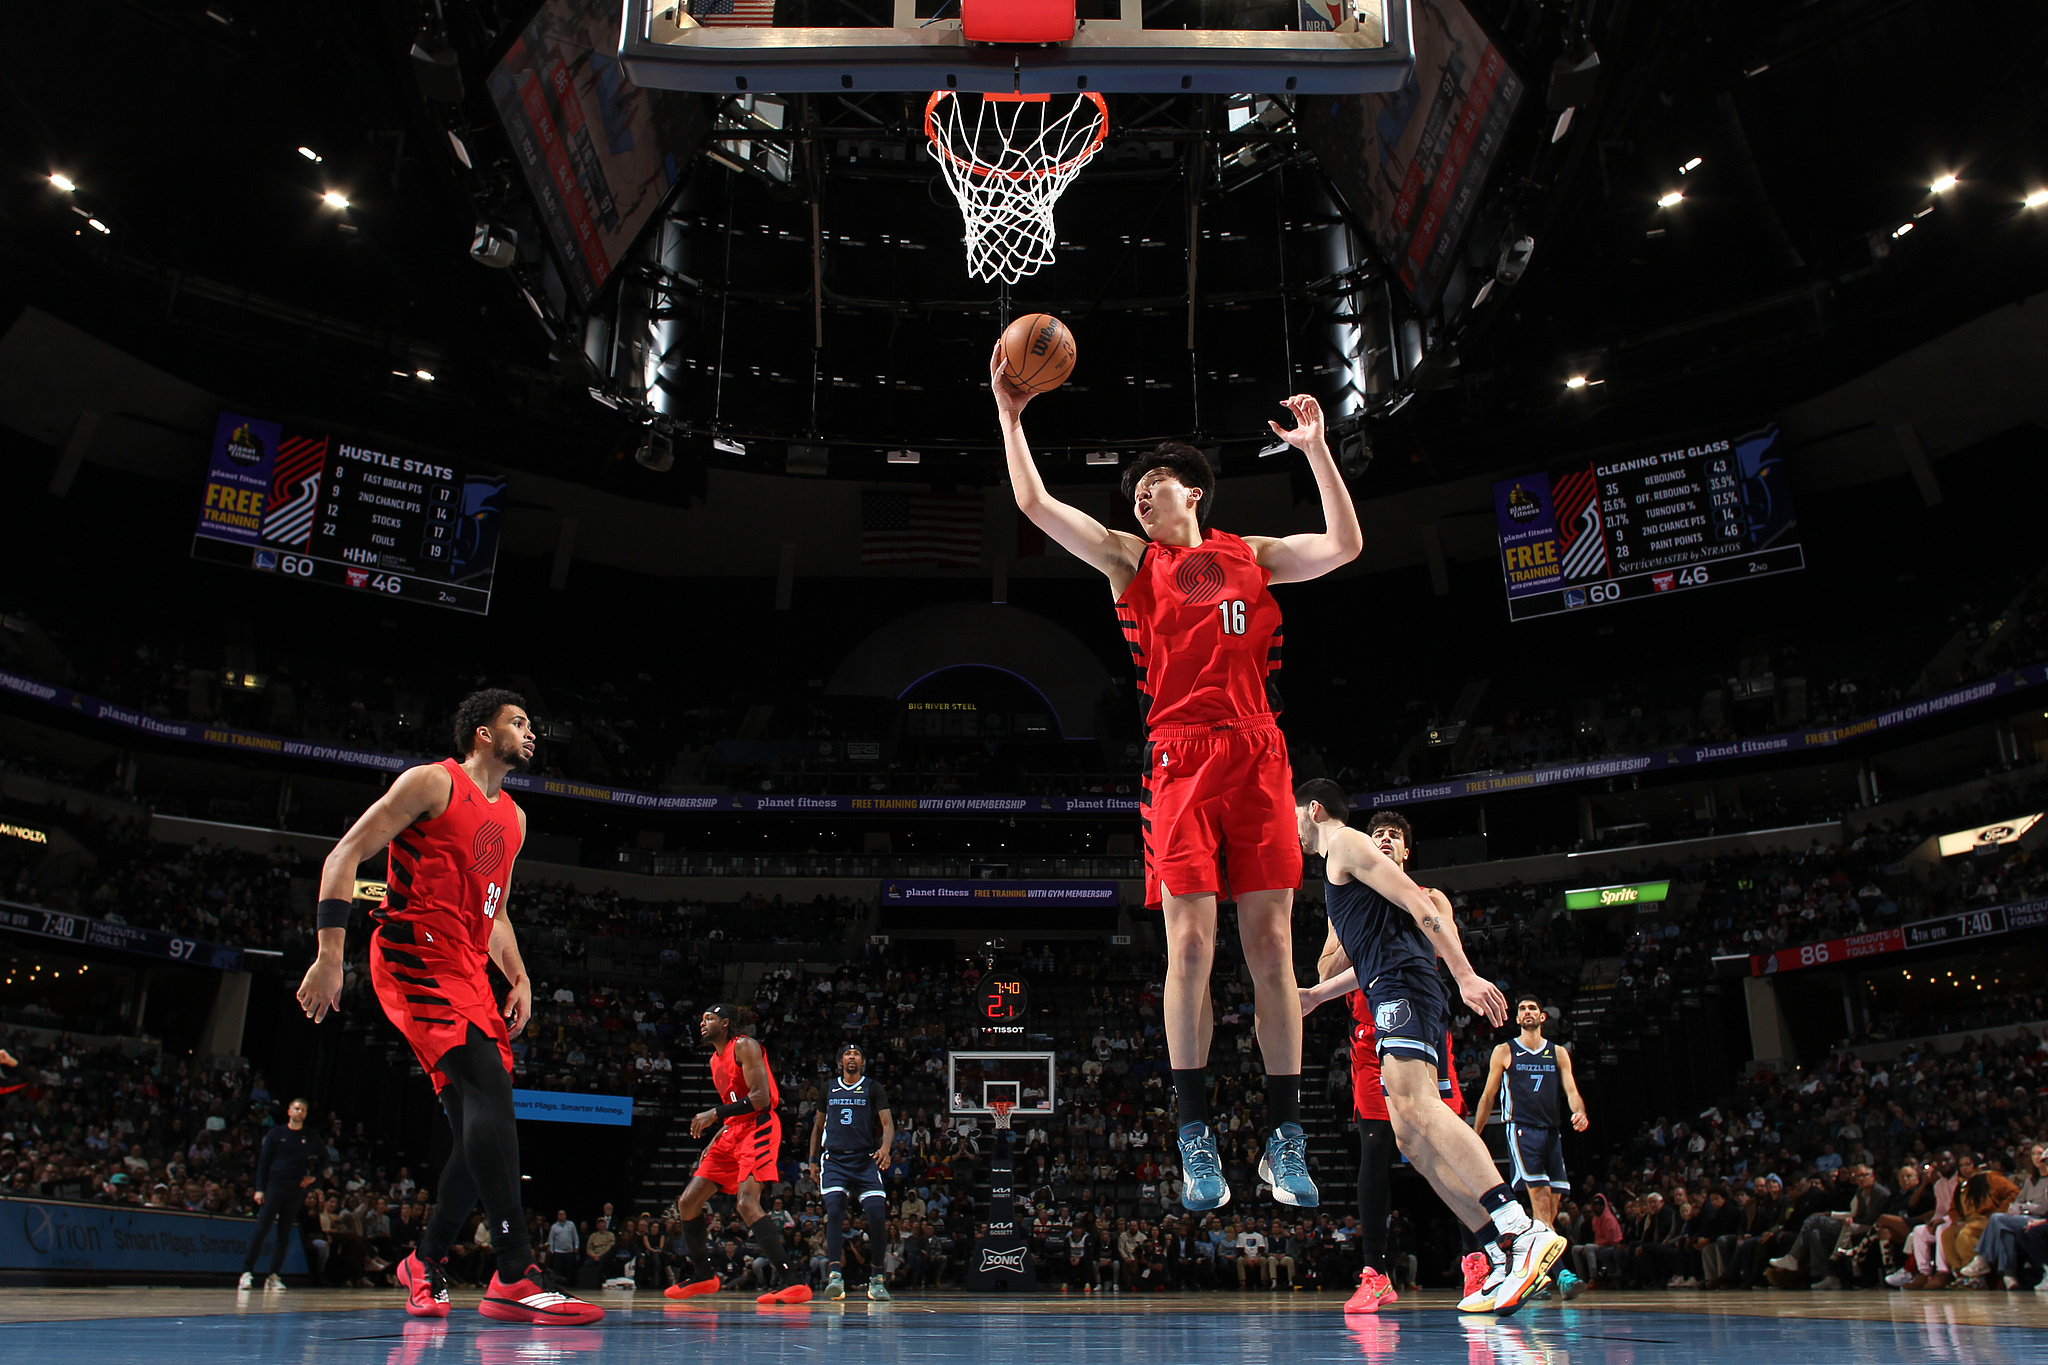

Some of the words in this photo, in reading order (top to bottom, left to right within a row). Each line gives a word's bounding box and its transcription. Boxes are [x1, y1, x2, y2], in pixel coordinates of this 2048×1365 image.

[1442, 72, 1455, 97] 97
[339, 444, 400, 469] HUSTLE
[403, 459, 453, 480] STATS
[1596, 455, 1658, 477] CLEANING
[1660, 449, 1686, 464] THE
[1687, 440, 1730, 456] GLASS
[211, 469, 238, 480] planet
[240, 474, 267, 486] fitness
[335, 466, 344, 478] 8
[363, 473, 382, 485] FAST
[382, 477, 407, 491] BREAK
[408, 483, 423, 494] PTS
[440, 489, 450, 501] 17
[1605, 482, 1619, 496] 35
[1644, 469, 1686, 486] REBOUNDS
[1713, 460, 1727, 473] 43
[205, 483, 264, 516] FREE
[332, 485, 340, 497] 9
[358, 491, 374, 503] 2ND
[376, 495, 405, 510] CHANCE
[407, 502, 421, 513] PTS
[436, 507, 447, 520] 14
[1603, 497, 1627, 513] 25.6%
[1636, 493, 1652, 505] OFF.
[1654, 485, 1690, 501] REBOUND
[1691, 483, 1700, 493] %
[1709, 474, 1736, 491] 35.9%
[204, 508, 259, 530] TRAINING
[1510, 502, 1534, 515] planet
[1513, 508, 1540, 518] fitness
[1605, 513, 1629, 529] 21.7%
[1645, 502, 1686, 519] TURNOVER
[1687, 501, 1696, 511] %
[1712, 491, 1738, 507] 17.5%
[327, 503, 339, 517] 12
[371, 513, 401, 529] STOCKS
[433, 526, 444, 538] 17
[1616, 530, 1624, 542] 9
[1642, 526, 1658, 536] 2ND
[1659, 518, 1690, 534] CHANCE
[1691, 515, 1706, 527] PTS
[1722, 508, 1735, 521] 14
[322, 522, 336, 536] 22
[371, 534, 395, 547] FOULS
[430, 545, 441, 558] 19
[1504, 532, 1527, 543] planet
[1528, 527, 1553, 537] fitness
[1616, 545, 1630, 558] 28
[1650, 537, 1673, 551] PAINT
[1674, 533, 1703, 546] POINTS
[1724, 524, 1739, 537] 46
[343, 548, 378, 565] HHM
[1505, 540, 1558, 571] FREE
[1690, 550, 1700, 560] by
[281, 555, 314, 577] 60
[371, 574, 401, 594] 46
[1509, 564, 1560, 582] TRAINING
[1589, 582, 1621, 603] 60
[1679, 565, 1710, 586] 46
[1219, 600, 1246, 635] 16
[98, 705, 140, 726] planet
[141, 716, 187, 736] fitness
[1805, 732, 1829, 745] FREE
[1832, 718, 1877, 741] TRAINING
[1878, 710, 1904, 727] WITH
[1905, 703, 1927, 720] GYM
[1929, 682, 1996, 712] MEMBERSHIP
[204, 730, 228, 743] FREE
[231, 733, 282, 751] TRAINING
[283, 741, 311, 756] WITH
[313, 746, 338, 760] GYM
[337, 750, 404, 769] MEMBERSHIP
[1695, 744, 1738, 761] planet
[1741, 739, 1788, 752] fitness
[1466, 781, 1487, 792] FREE
[1489, 774, 1534, 791] TRAINING
[1535, 771, 1561, 783] WITH
[1563, 767, 1585, 779] GYM
[1586, 757, 1650, 776] MEMBERSHIP
[544, 781, 565, 793] FREE
[568, 785, 610, 800] TRAINING
[611, 792, 636, 803] WITH
[636, 795, 658, 806] GYM
[658, 797, 718, 808] MEMBERSHIP
[757, 797, 794, 809] planet
[797, 797, 837, 808] fitness
[852, 799, 872, 809] FREE
[874, 799, 917, 809] TRAINING
[919, 799, 944, 809] WITH
[944, 799, 967, 809] GYM
[967, 799, 1026, 809] MEMBERSHIP
[1066, 799, 1103, 810] planet
[1106, 799, 1140, 809] fitnes
[1372, 790, 1409, 806] planet
[1412, 785, 1451, 798] fitness
[484, 882, 501, 919] 33
[906, 888, 935, 899] planet
[938, 888, 969, 897] fitness
[992, 890, 1027, 898] TRAINING
[1028, 890, 1047, 898] WITH
[1048, 890, 1065, 898] GYM
[1065, 890, 1112, 898] MEMBERSHIP
[1600, 888, 1638, 905] Sprite
[41, 912, 75, 937] 7:40
[91, 922, 138, 939] TIMEOUTS:
[1911, 927, 1929, 942] 4TH
[1958, 912, 1993, 936] 7:40
[169, 938, 196, 960] 97
[1845, 932, 1891, 947] TIMEOUTS:
[1846, 945, 1877, 957] FOULS:
[1878, 943, 1885, 952] 2
[1800, 943, 1829, 965] 86
[994, 982, 1020, 994] 7:40
[988, 994, 1013, 1017] 2.1
[1516, 1064, 1556, 1072] GRIZZLIES
[1530, 1074, 1544, 1092] 7
[535, 1102, 558, 1111] Plays.
[561, 1103, 593, 1112] Smarter
[595, 1106, 624, 1115] Money.
[829, 1098, 866, 1106] GRIZZLIES
[840, 1108, 853, 1125] 3
[114, 1229, 158, 1251] Smart
[986, 1256, 1020, 1265] SONIC
